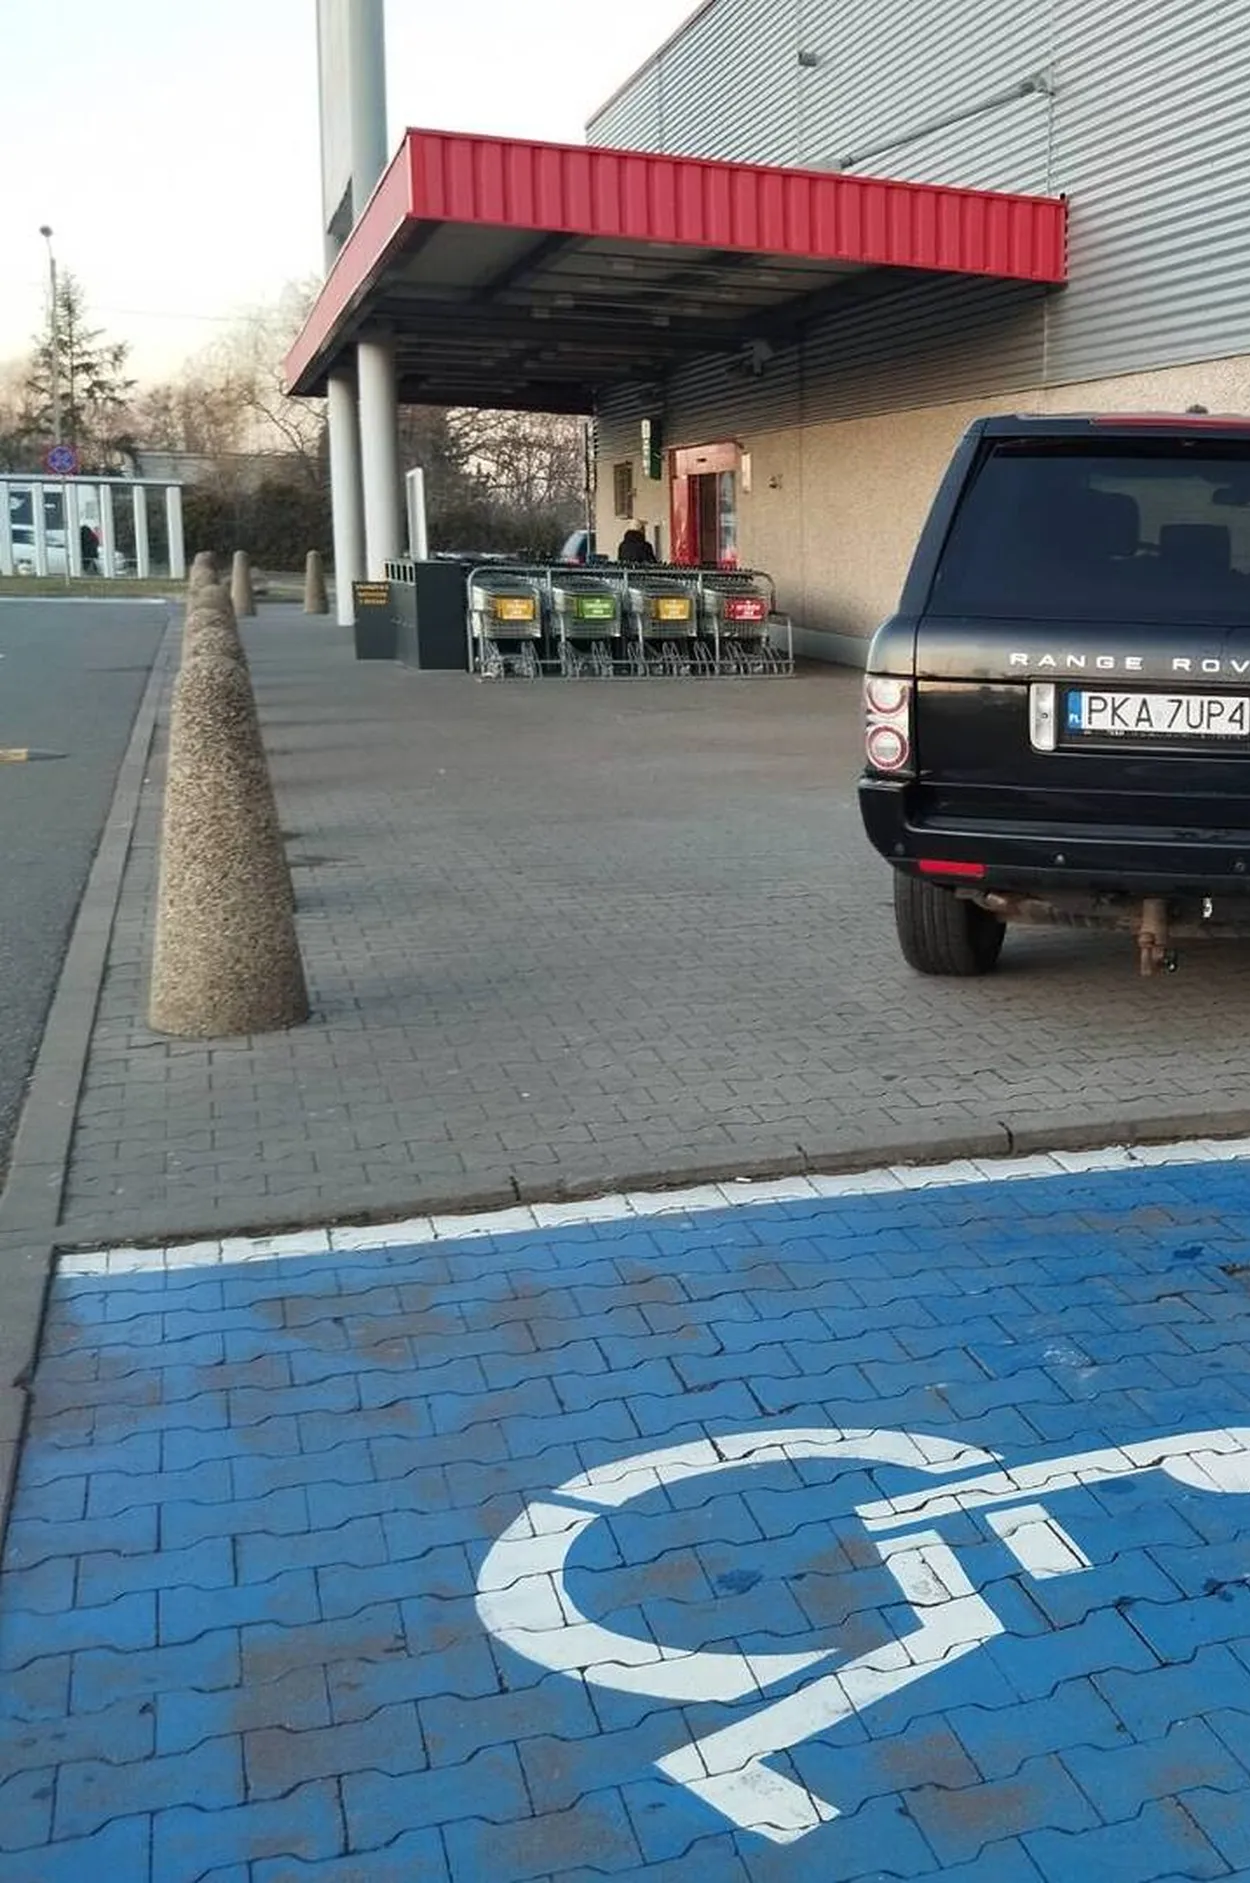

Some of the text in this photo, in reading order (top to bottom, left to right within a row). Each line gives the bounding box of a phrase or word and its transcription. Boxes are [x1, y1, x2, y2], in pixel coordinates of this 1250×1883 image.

[1009, 652, 1144, 671] RANGE
[1087, 696, 1245, 731] PKA 7UP4
